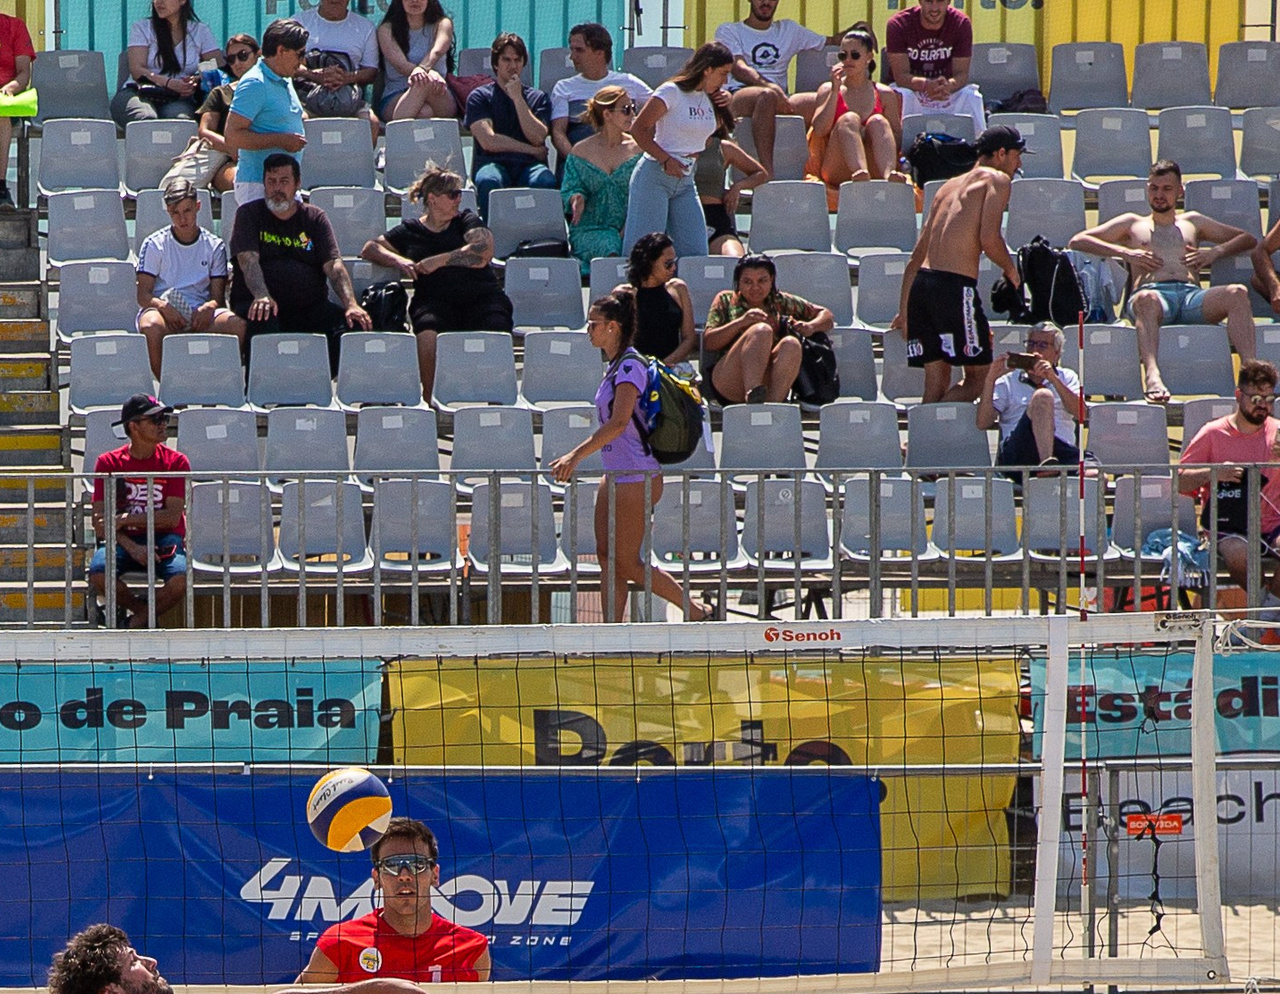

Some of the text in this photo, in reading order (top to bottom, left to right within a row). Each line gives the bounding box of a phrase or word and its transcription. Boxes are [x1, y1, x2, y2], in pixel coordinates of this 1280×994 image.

[782, 628, 841, 641] Senoh
[60, 688, 147, 730] de
[165, 688, 356, 729] Praia
[510, 935, 573, 946] ZONE
